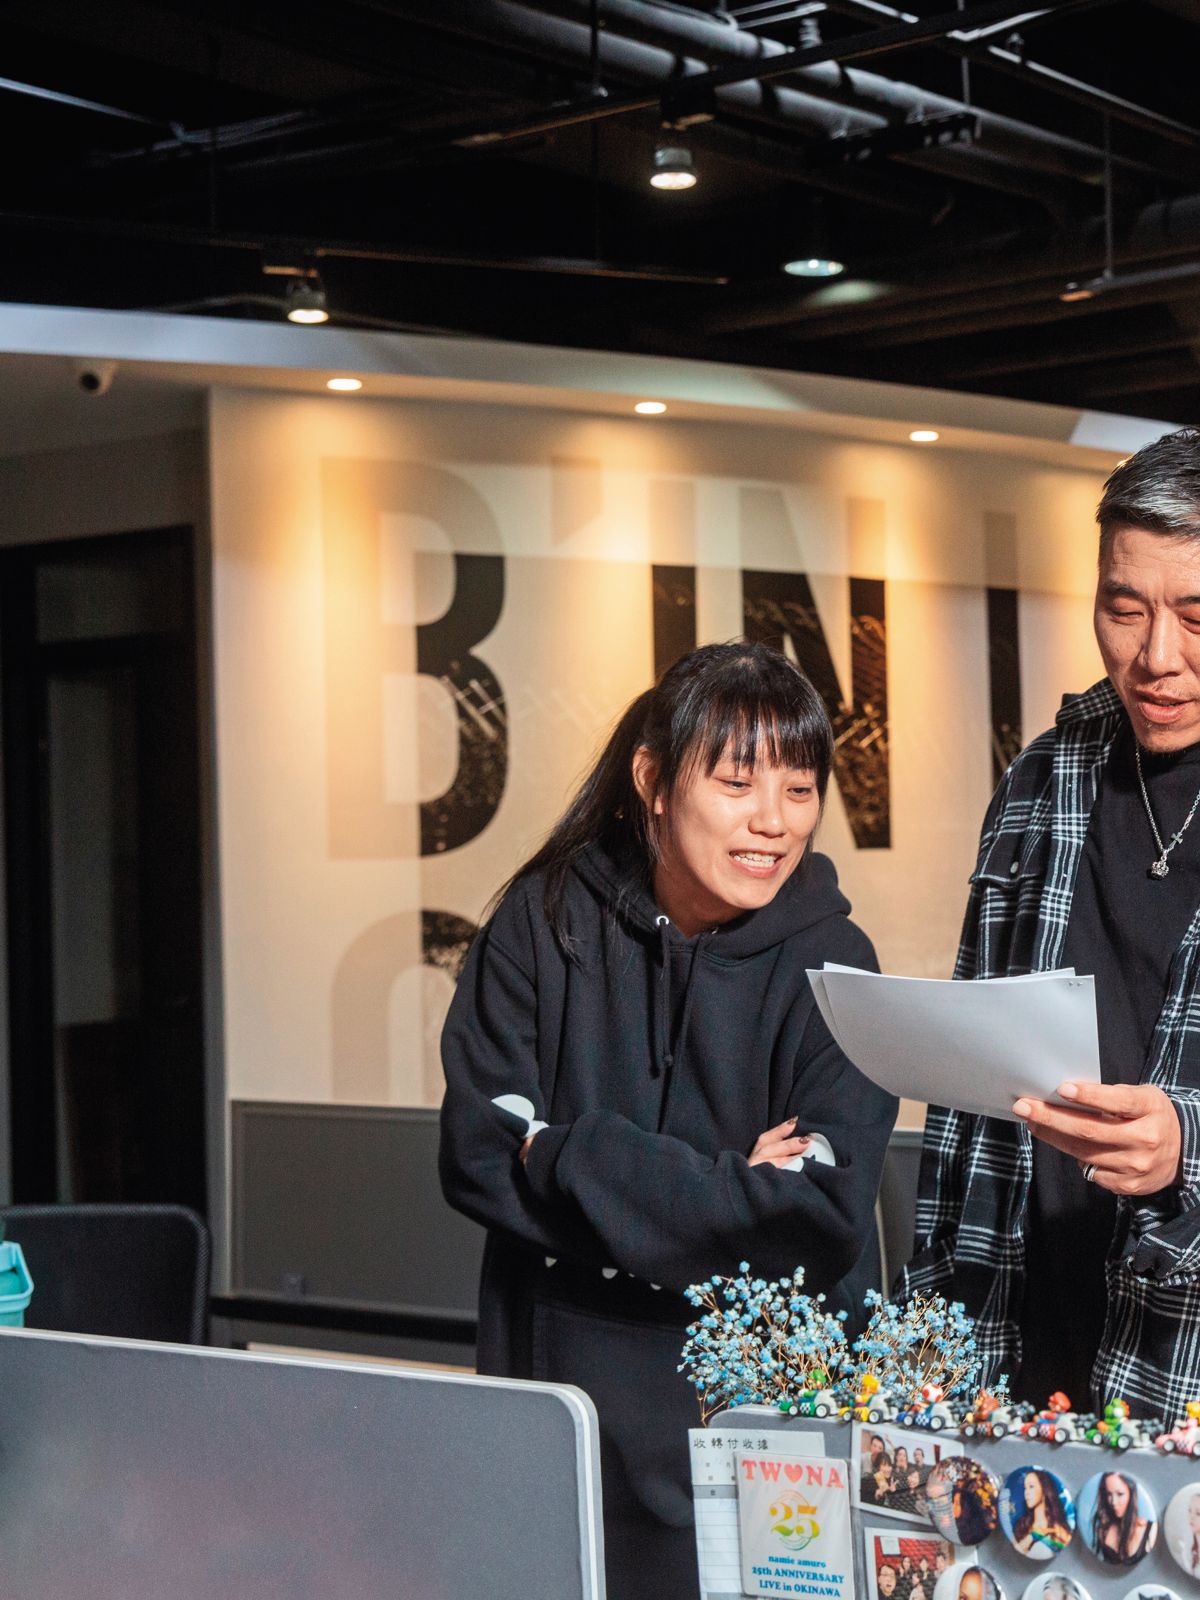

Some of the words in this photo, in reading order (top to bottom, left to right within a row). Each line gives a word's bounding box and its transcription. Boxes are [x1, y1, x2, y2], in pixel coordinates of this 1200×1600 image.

[768, 1502, 821, 1539] 25
[768, 1555, 795, 1565] namie
[797, 1559, 827, 1568] amuro
[752, 1566, 772, 1576] 25th
[774, 1568, 845, 1584] ANNIVERSARY
[759, 1579, 782, 1590] LIVE
[783, 1582, 792, 1592] in
[794, 1584, 841, 1597] OKINAWA
